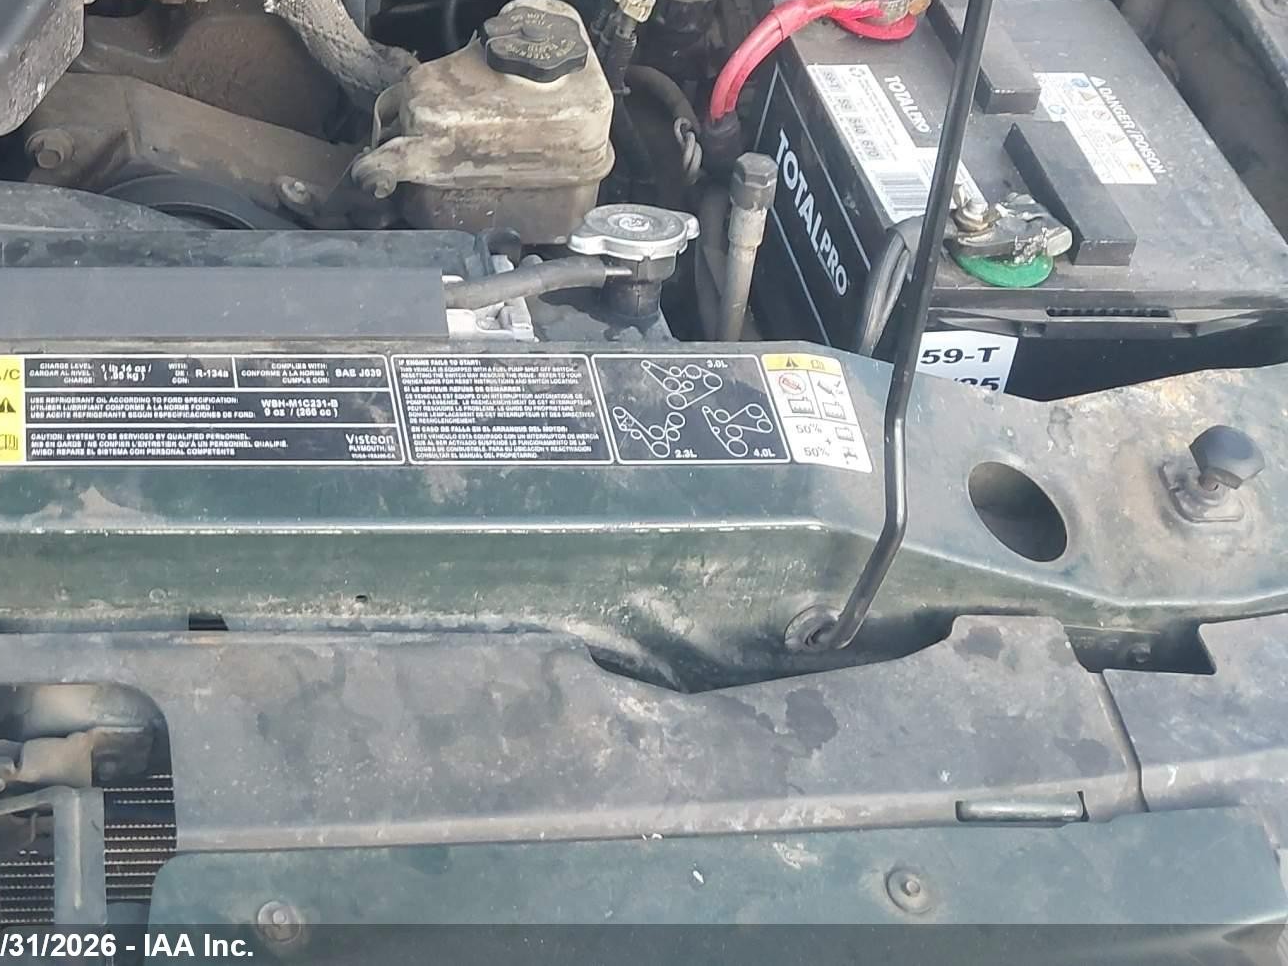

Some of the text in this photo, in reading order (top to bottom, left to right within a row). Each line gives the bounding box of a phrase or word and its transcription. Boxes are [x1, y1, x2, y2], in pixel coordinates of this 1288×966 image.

[884, 75, 931, 132] TOTALPRO
[1098, 87, 1136, 131] DANGER
[1129, 134, 1167, 174] POISON
[776, 128, 848, 296] TOTALPRO
[920, 347, 1000, 365] 59-T
[195, 369, 229, 378] R-134a
[346, 434, 394, 444] Visteon
[674, 449, 698, 458] 2.3L
[753, 448, 776, 458] 4.0L
